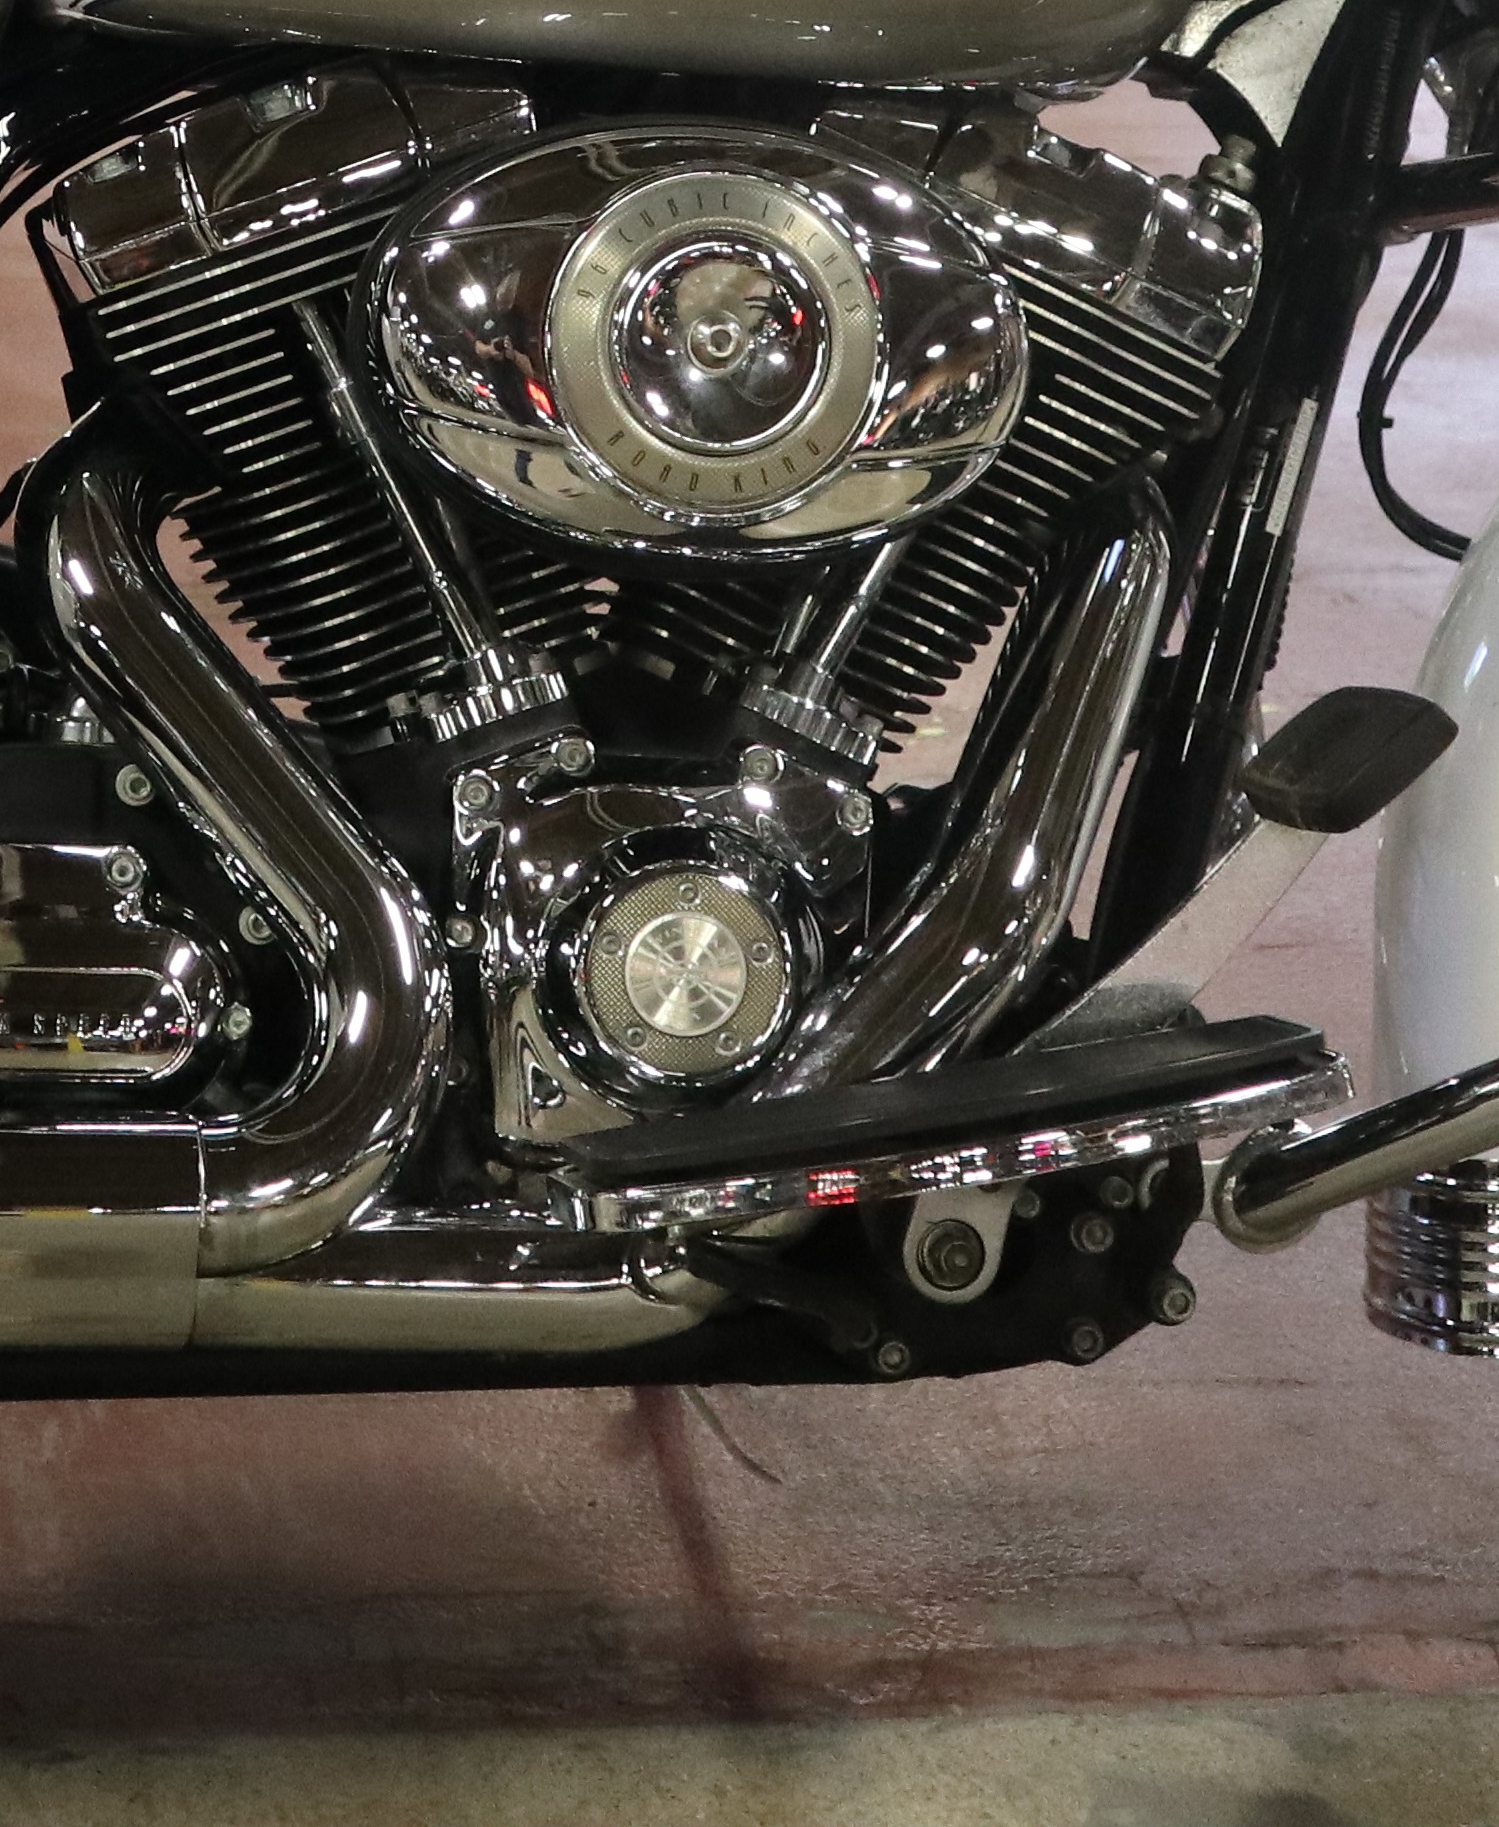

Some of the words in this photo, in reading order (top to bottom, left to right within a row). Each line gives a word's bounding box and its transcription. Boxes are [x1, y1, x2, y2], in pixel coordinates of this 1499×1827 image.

[576, 261, 608, 301] 96
[617, 191, 729, 244] CUBIC
[761, 199, 862, 315] INCHES
[606, 430, 700, 493] ROAD
[732, 438, 821, 494] KING
